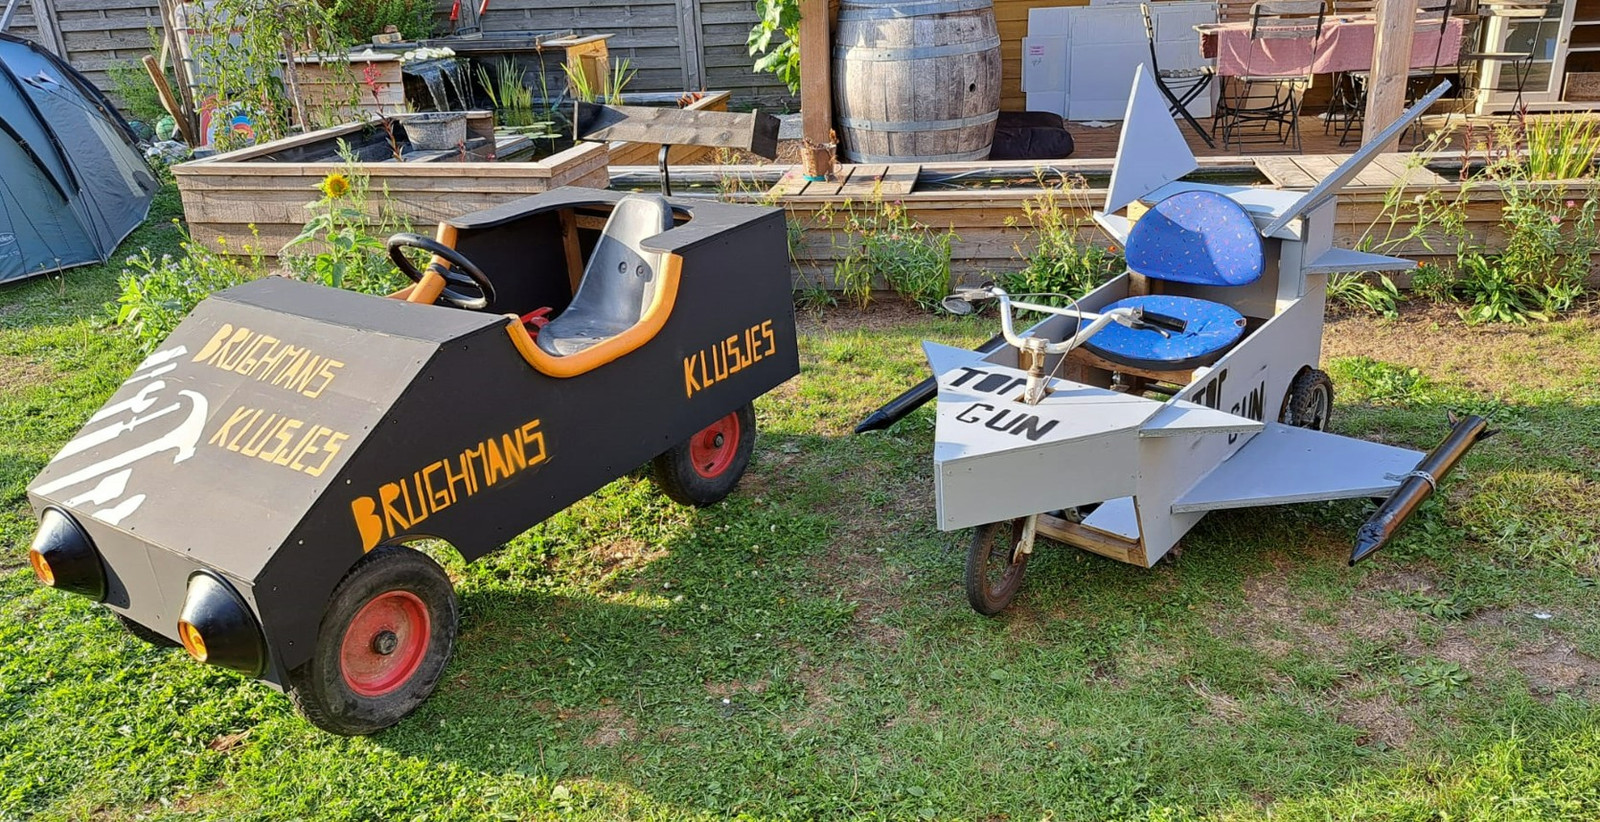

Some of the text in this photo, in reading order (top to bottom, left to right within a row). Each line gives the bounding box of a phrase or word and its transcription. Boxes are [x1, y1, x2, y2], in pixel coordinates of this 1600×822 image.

[192, 323, 345, 399] BRUGHMANS
[683, 319, 776, 399] KLUSJES
[208, 406, 350, 477] KLUSJES
[955, 403, 1060, 441] GUN
[351, 418, 548, 554] BRUGHMANS
